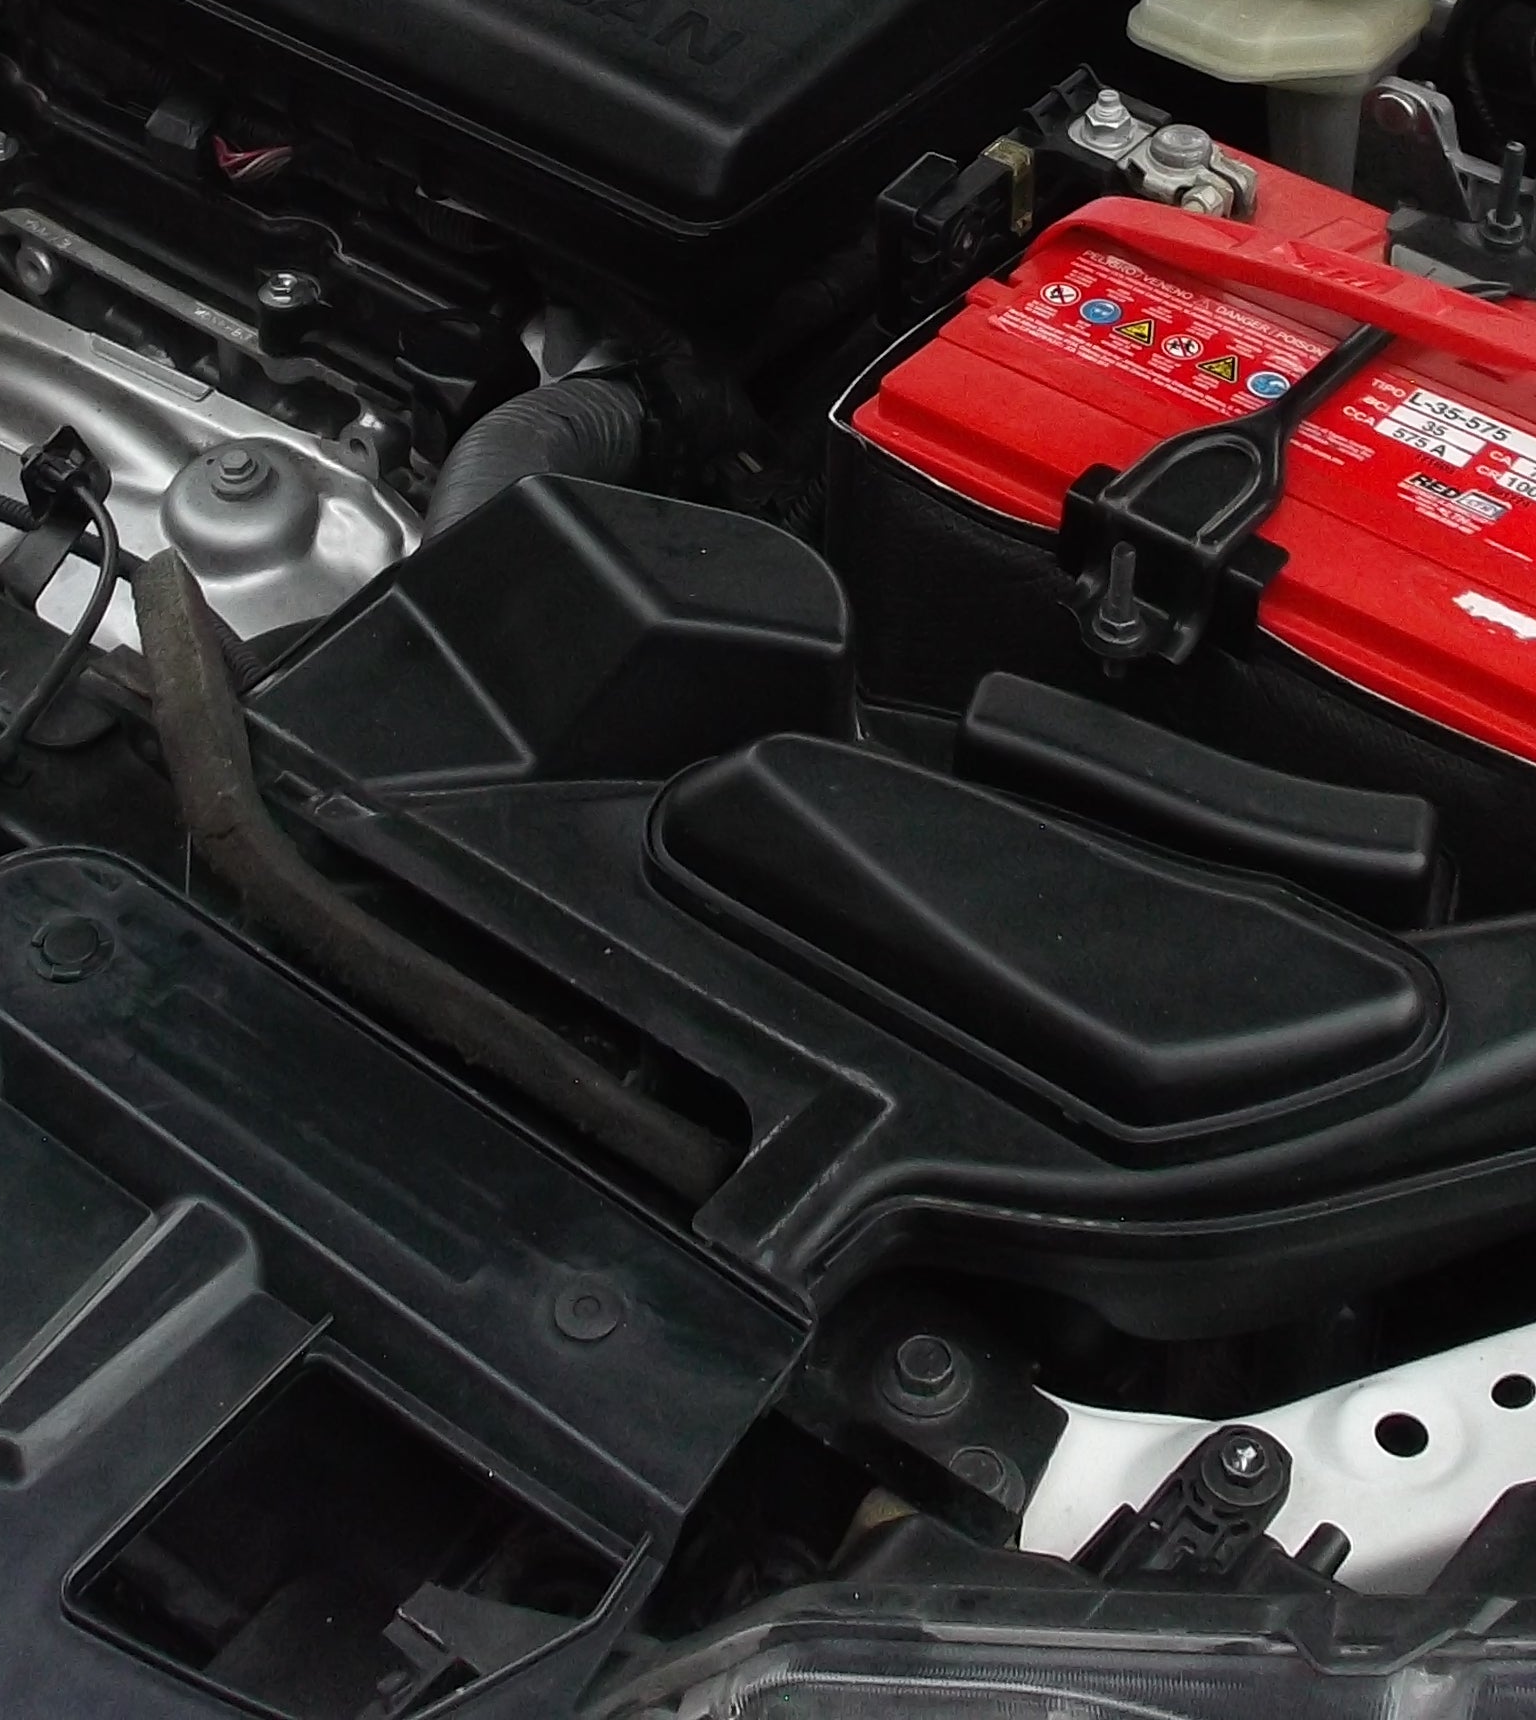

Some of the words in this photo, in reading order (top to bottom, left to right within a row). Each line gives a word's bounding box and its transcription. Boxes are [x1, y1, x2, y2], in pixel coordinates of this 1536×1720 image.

[1082, 250, 1137, 276] PELIGRO
[1143, 274, 1194, 300] VENENO
[1215, 305, 1271, 333] DANGER
[1276, 331, 1329, 357] POISON
[1342, 405, 1376, 426] CCA
[1392, 428, 1429, 449] 575
[1430, 444, 1447, 458] A
[1371, 378, 1406, 398] TIPO
[1409, 391, 1511, 442] L-35-575
[1420, 420, 1446, 437] 35
[1489, 450, 1513, 467] CA
[1409, 473, 1463, 499] RED
